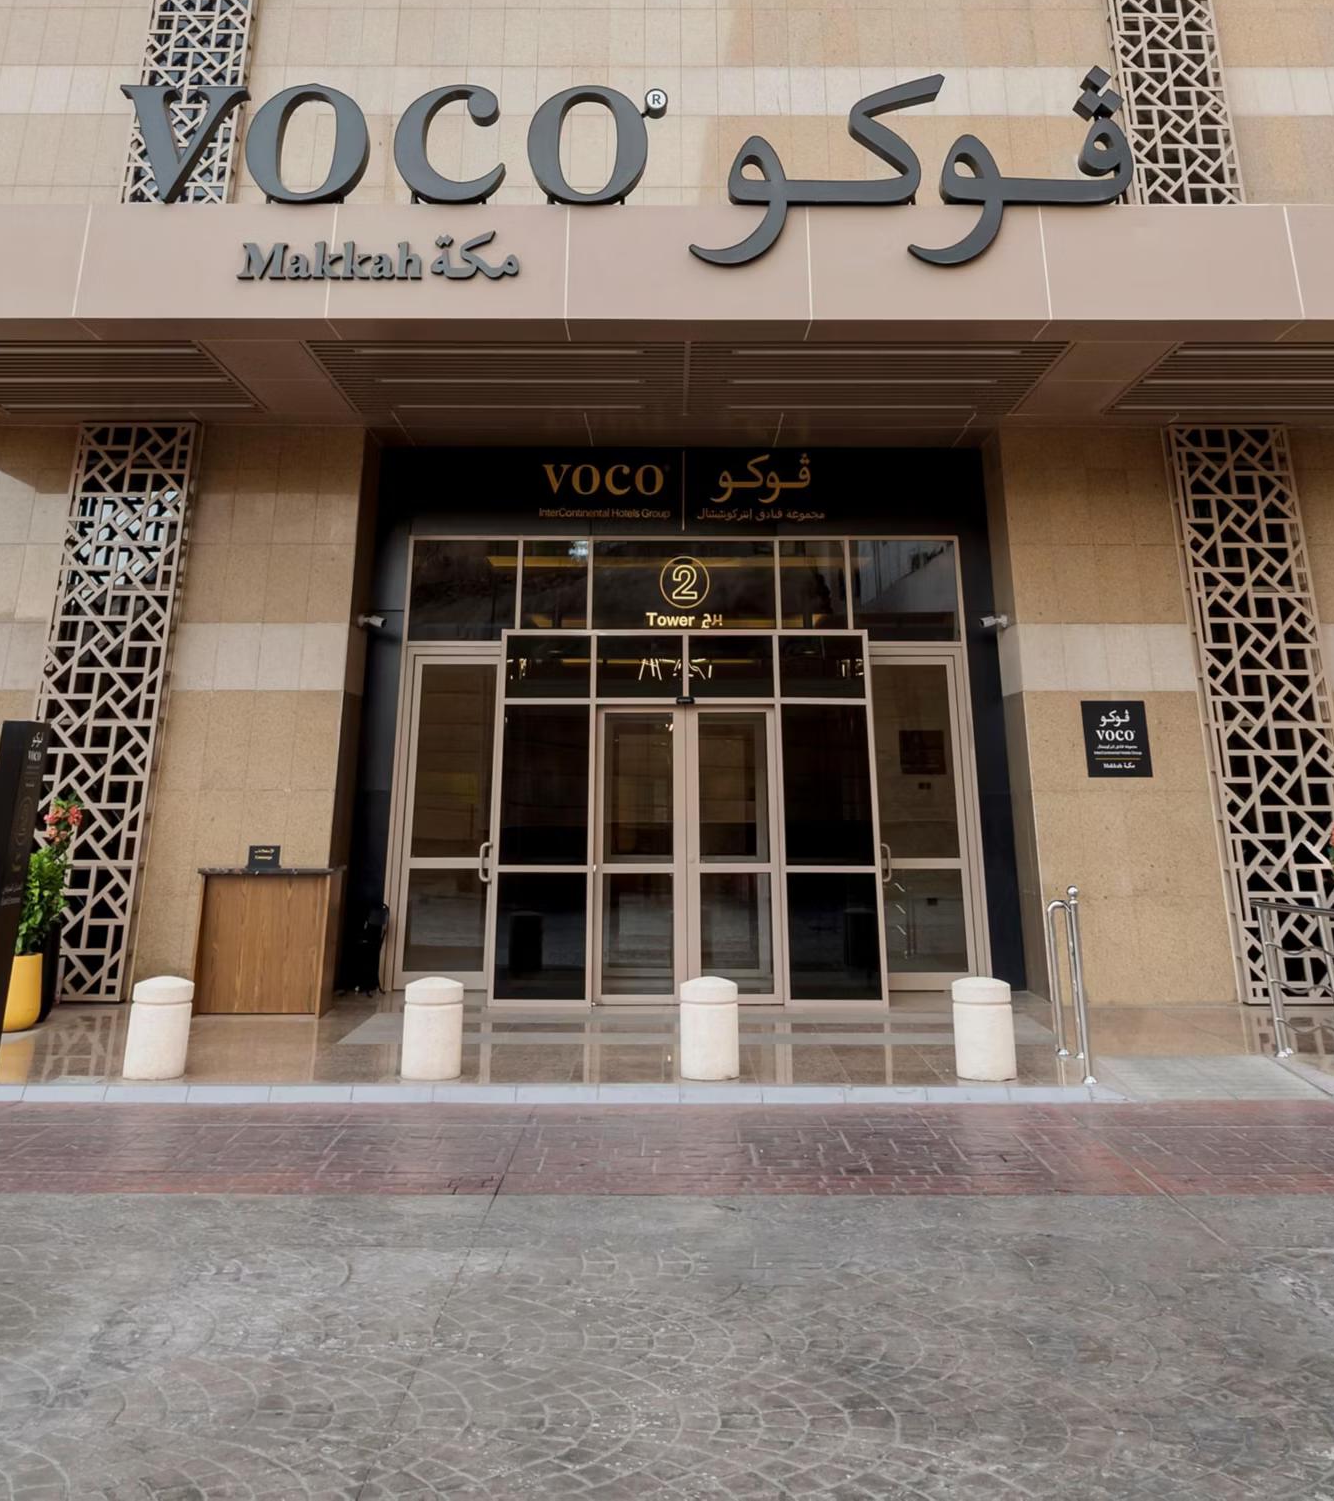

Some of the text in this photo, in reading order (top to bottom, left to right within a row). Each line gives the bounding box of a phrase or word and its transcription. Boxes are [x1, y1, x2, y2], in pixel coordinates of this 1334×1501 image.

[236, 230, 521, 280] Makkah مكة
[539, 507, 671, 521] InterContinental Hotels Group
[671, 564, 699, 600] 2
[645, 611, 696, 627] Tower
